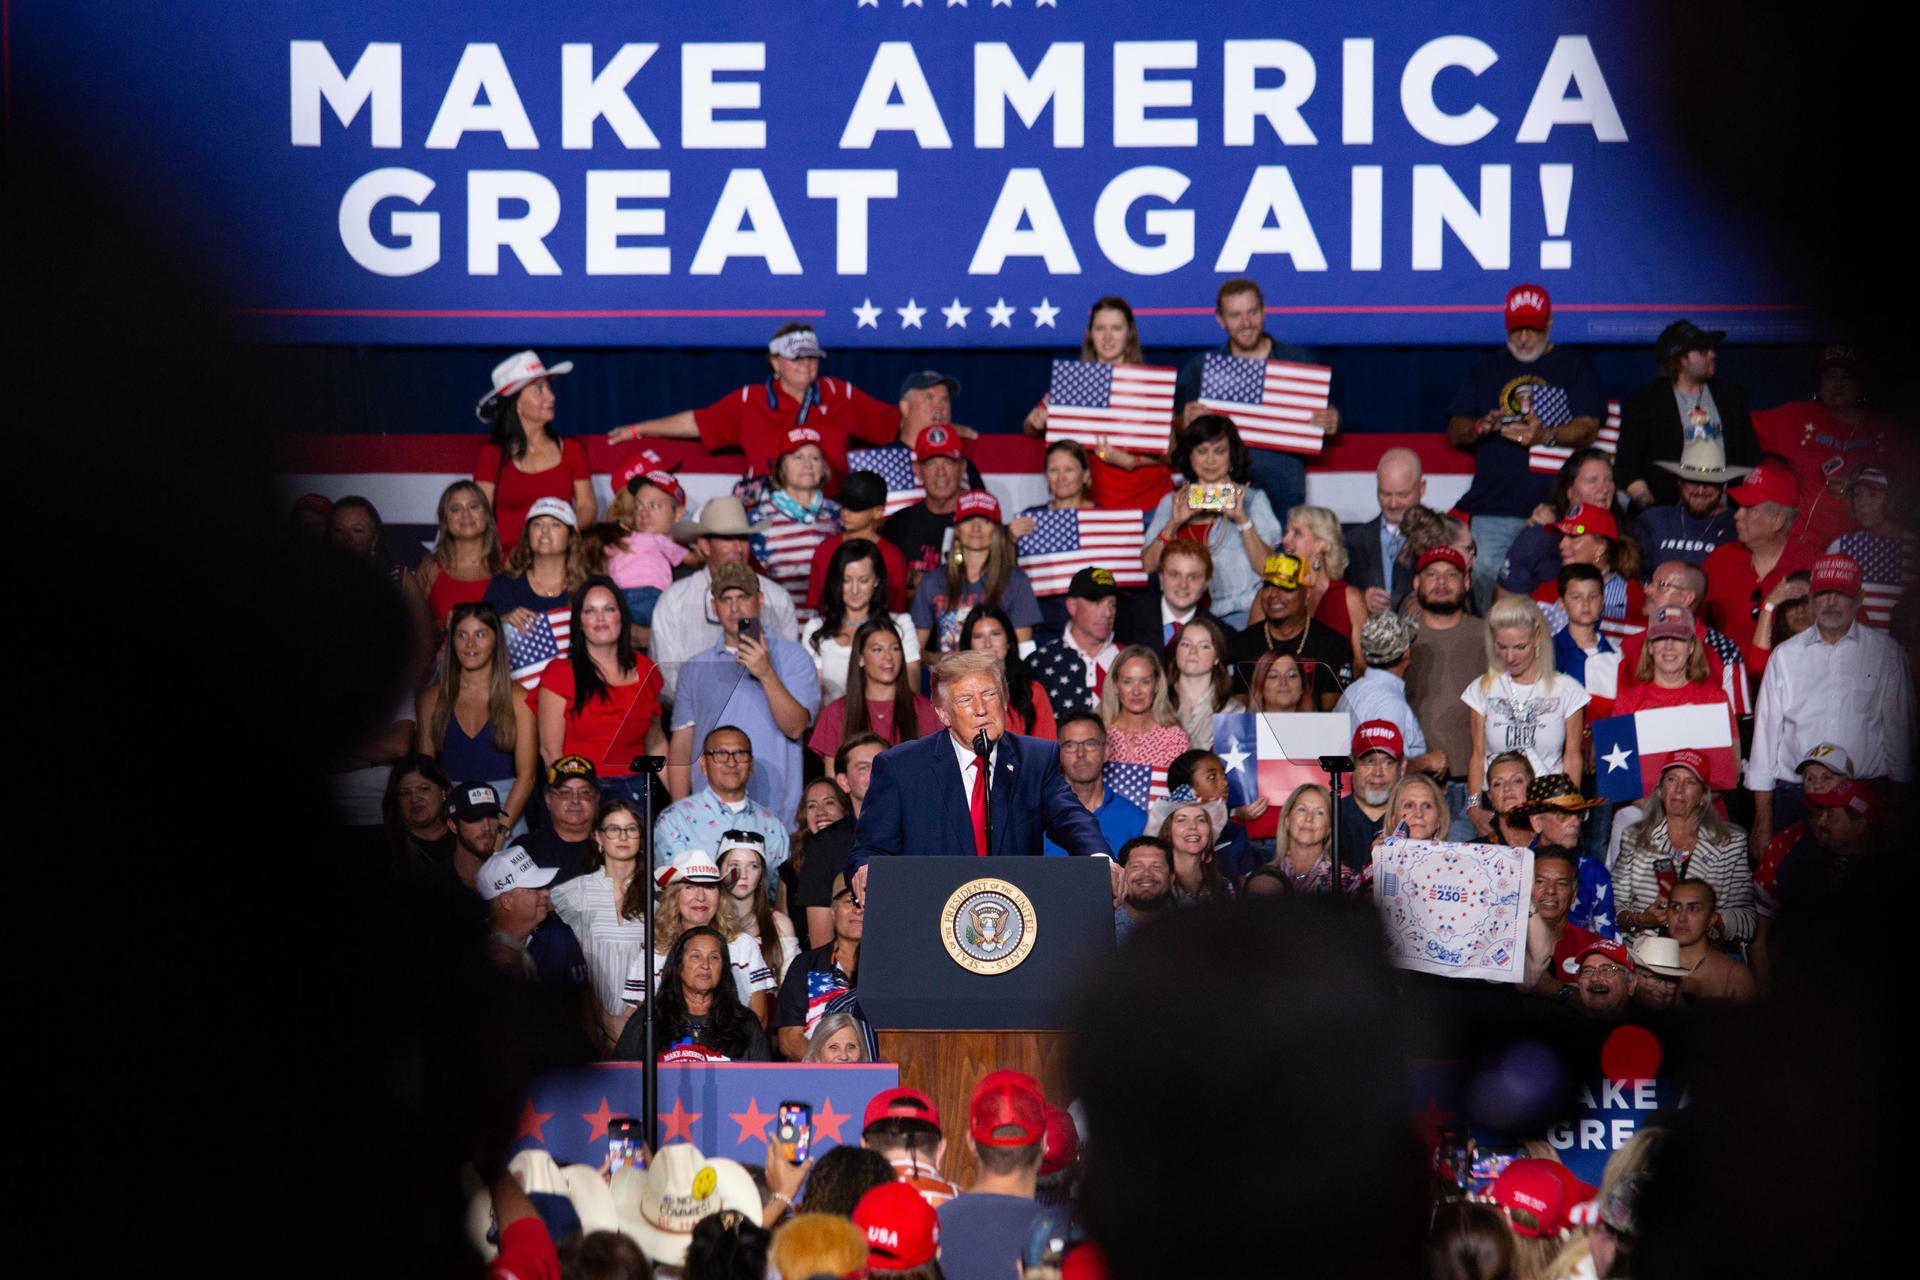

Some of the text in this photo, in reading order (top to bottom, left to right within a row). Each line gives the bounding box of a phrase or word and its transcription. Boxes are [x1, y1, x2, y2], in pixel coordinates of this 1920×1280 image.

[290, 35, 1629, 149] MAKE AMERICA
[338, 163, 1573, 276] GREAT AGAIN!
[1660, 539, 1716, 553] FREEDO
[1360, 727, 1395, 740] TRUMP
[685, 865, 718, 876] TRUMP
[494, 873, 515, 890] 45-47
[1001, 885, 1014, 895] THE
[1432, 884, 1466, 892] AMERICA
[945, 882, 989, 922] PRESIDENT
[1437, 890, 1461, 902] 250
[1014, 894, 1034, 934] UNITED
[945, 926, 953, 940] THE
[949, 940, 957, 950] OF
[955, 948, 980, 969] SEAL
[996, 941, 1030, 970] STATES
[1577, 1078, 1658, 1110] AKE
[1547, 1119, 1636, 1150] GRE
[867, 1226, 898, 1248] USA
